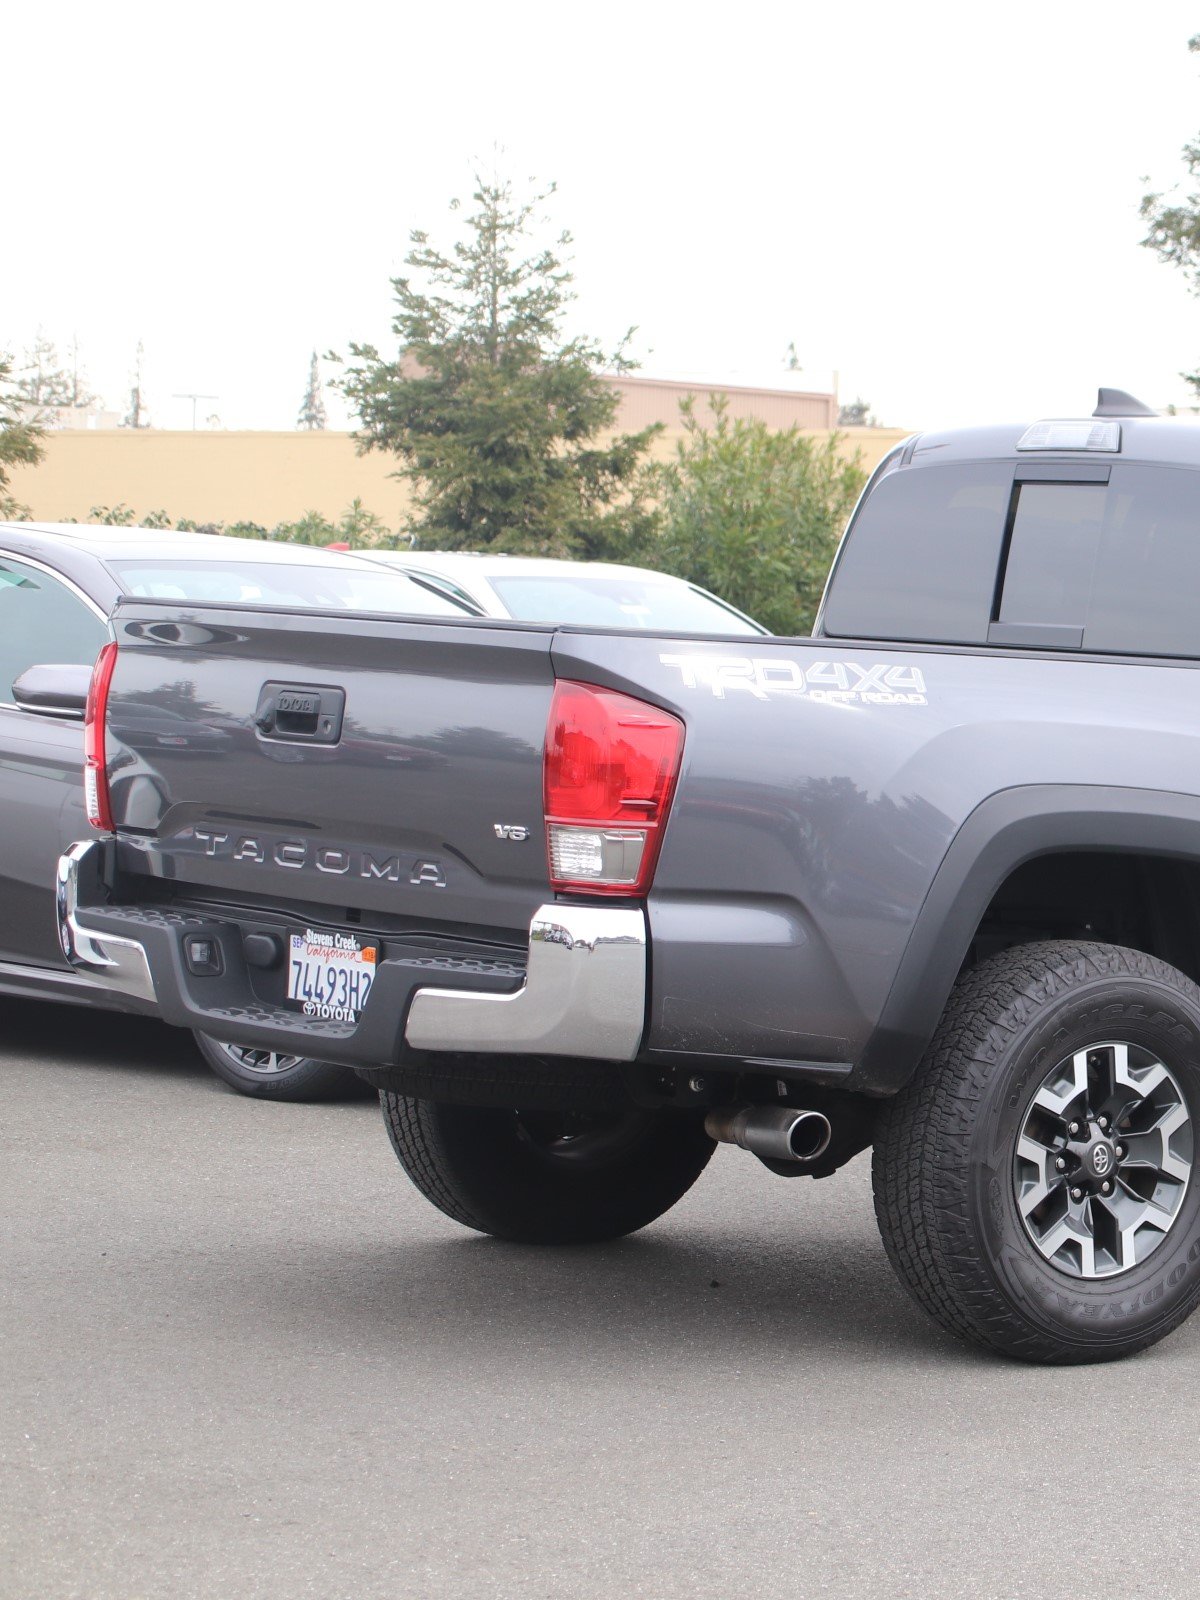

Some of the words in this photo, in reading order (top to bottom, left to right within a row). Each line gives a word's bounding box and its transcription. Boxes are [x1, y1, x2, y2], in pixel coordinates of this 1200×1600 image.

[659, 654, 806, 700] TRD
[279, 698, 313, 712] TOYOTA
[494, 824, 531, 842] V6
[193, 826, 447, 888] TACOMA
[306, 928, 334, 947] Stevens
[335, 933, 357, 950] Creek
[306, 943, 361, 964] California
[316, 1004, 356, 1023] TOYOTA
